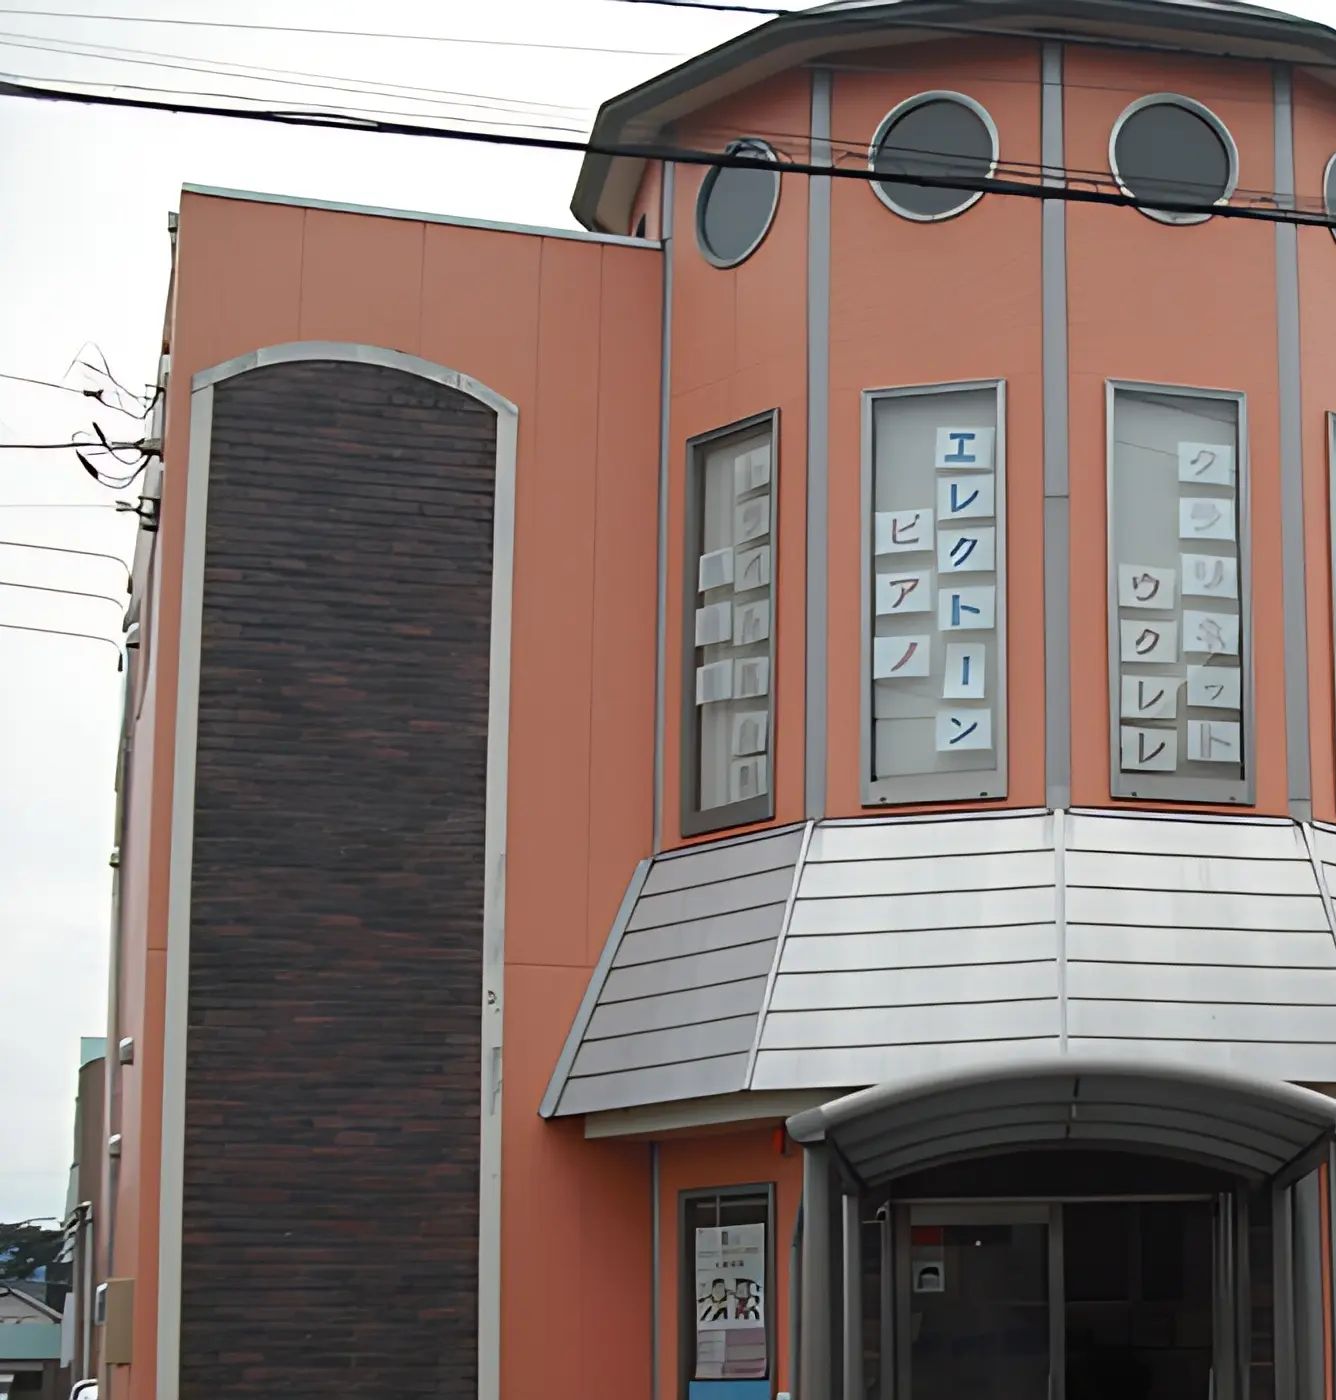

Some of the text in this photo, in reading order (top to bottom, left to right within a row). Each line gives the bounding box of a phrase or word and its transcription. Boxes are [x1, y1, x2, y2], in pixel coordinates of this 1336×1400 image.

[943, 432, 981, 745] エレクトーン
[1132, 572, 1166, 764] ウクレレ
